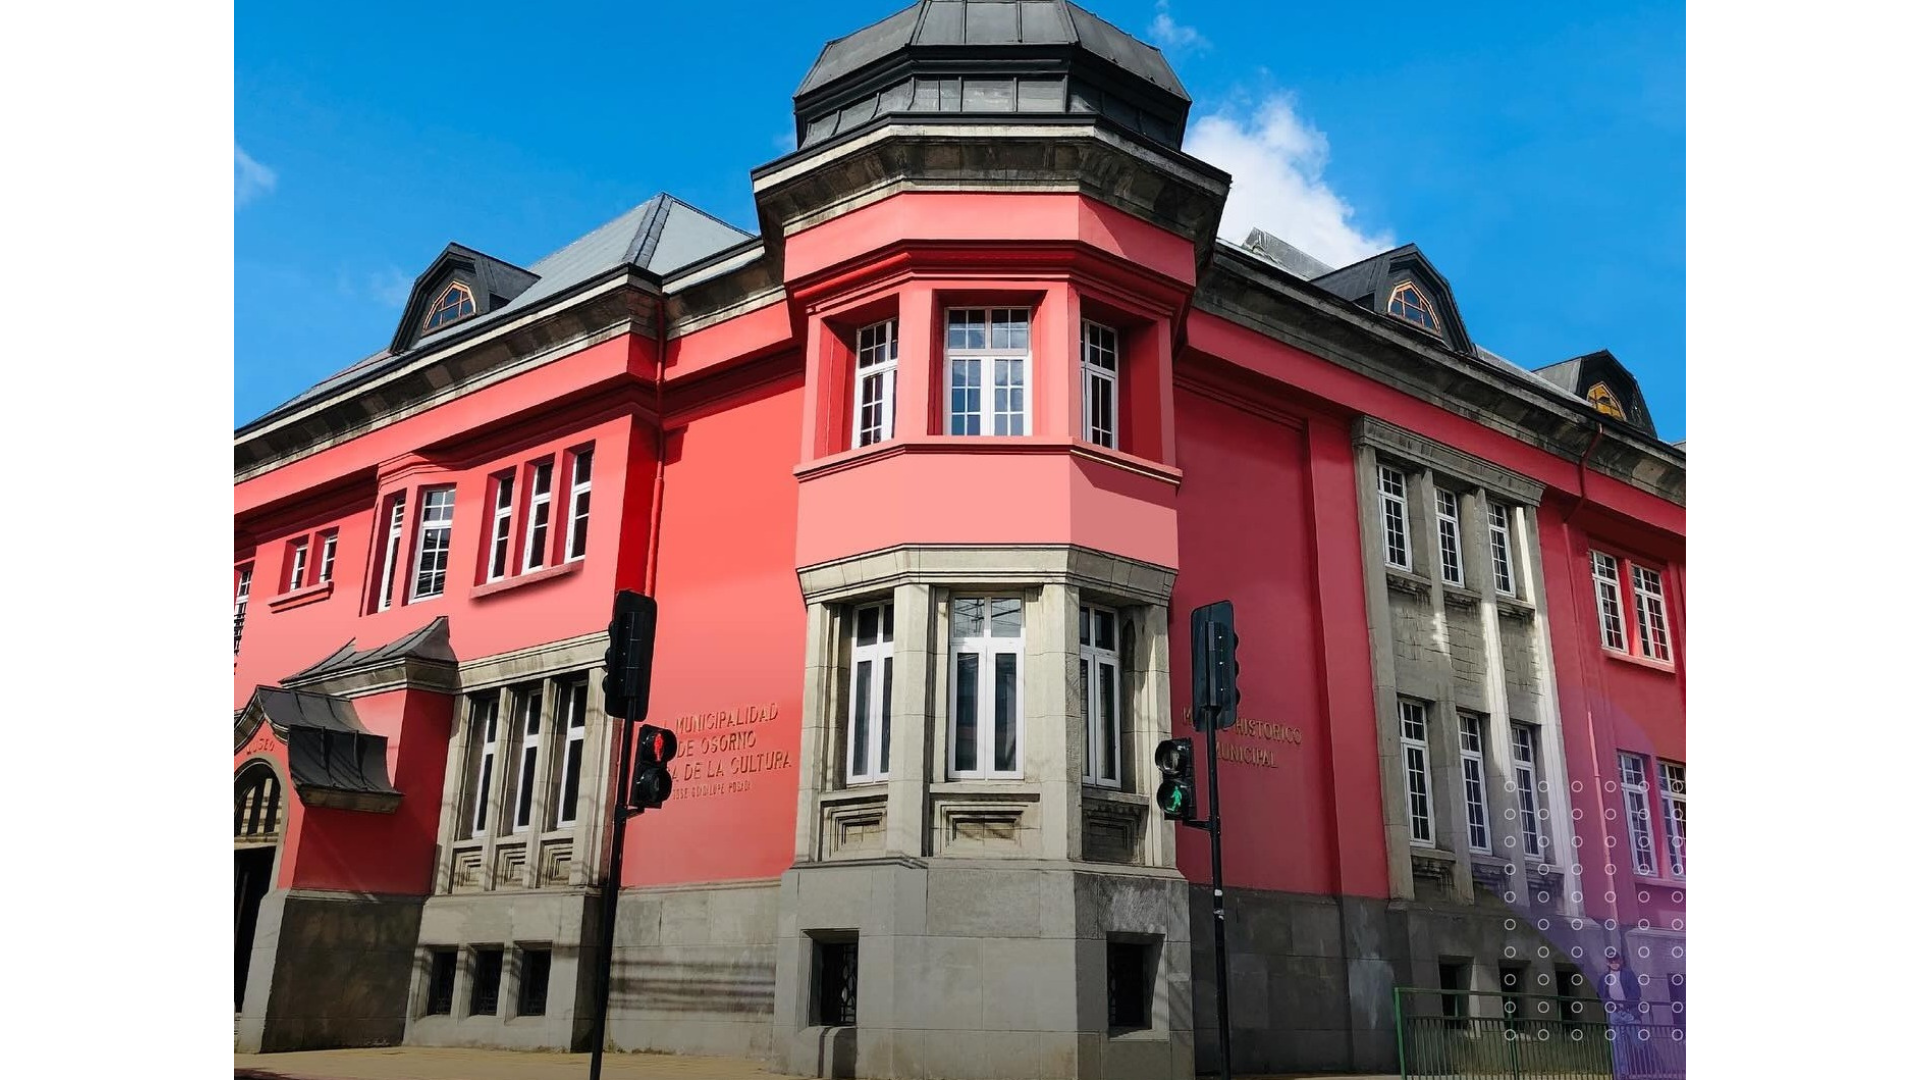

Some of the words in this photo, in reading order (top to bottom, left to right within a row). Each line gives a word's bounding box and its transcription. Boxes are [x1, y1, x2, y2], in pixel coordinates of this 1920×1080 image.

[675, 702, 779, 734] MUNICIPALIDAD
[1235, 718, 1302, 745] HISTORICO
[677, 739, 694, 759] DE
[701, 730, 756, 755] OSORNO
[684, 762, 702, 781] DE
[707, 760, 724, 778] LA
[731, 751, 792, 774] CULTURA
